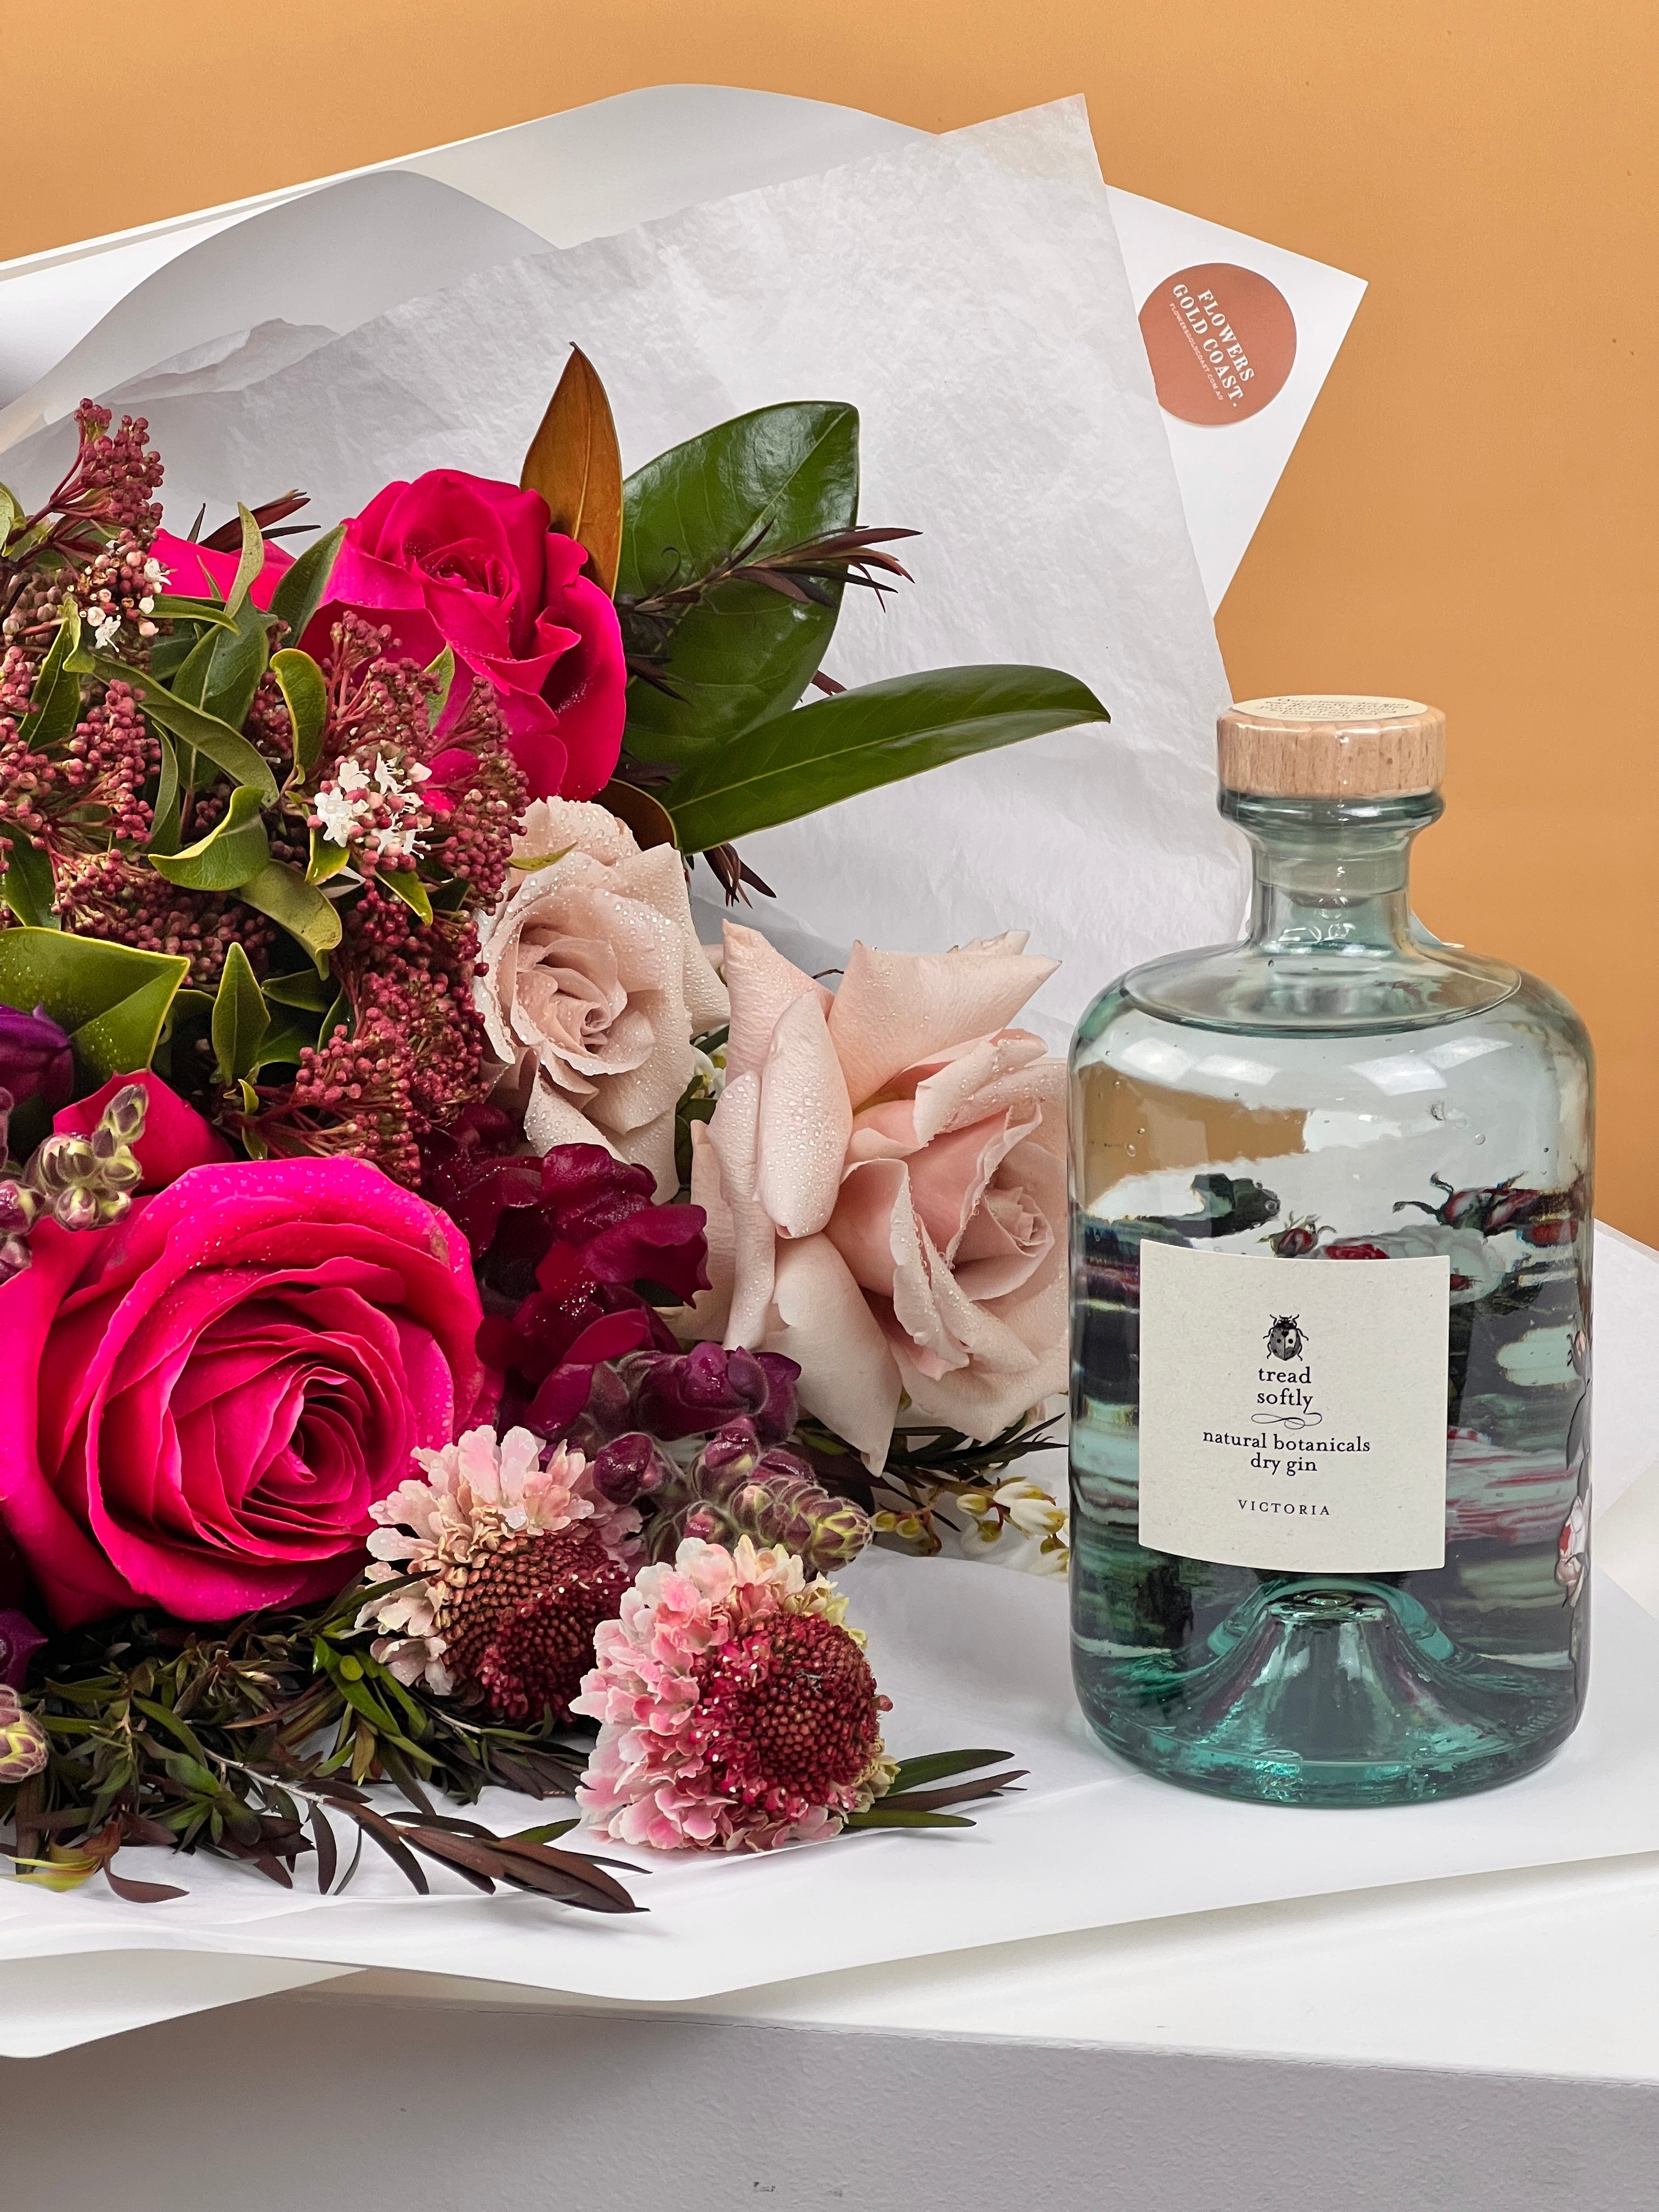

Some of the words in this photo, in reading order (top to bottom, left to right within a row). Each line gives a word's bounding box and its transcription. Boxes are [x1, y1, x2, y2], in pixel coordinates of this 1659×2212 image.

[1173, 284, 1208, 334] GOLD
[1203, 338, 1244, 407] COAST.
[1198, 289, 1255, 381] FLOWERS
[1259, 1367, 1312, 1384] tread
[1257, 1388, 1313, 1414] softly
[1203, 1432, 1267, 1448] natural
[1273, 1434, 1370, 1452] botanicals
[1251, 1452, 1281, 1475] dry
[1286, 1457, 1318, 1476] gin
[1238, 1499, 1330, 1515] VICTORIA
